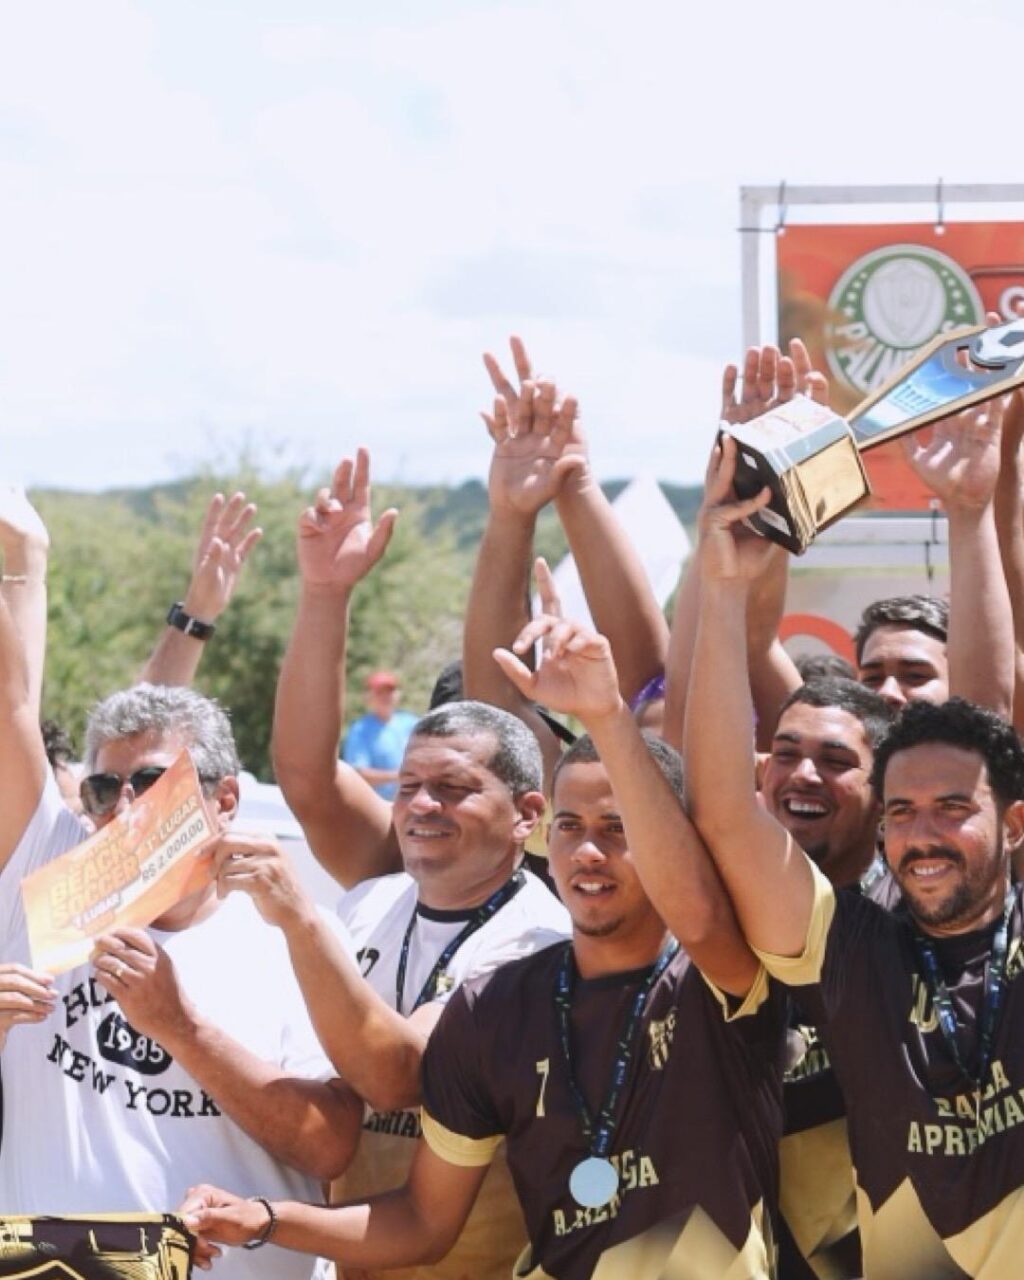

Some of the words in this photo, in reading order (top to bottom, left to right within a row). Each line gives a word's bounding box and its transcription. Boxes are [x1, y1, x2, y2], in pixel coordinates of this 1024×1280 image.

[48, 1033, 115, 1094] NEW
[125, 1080, 221, 1116] YORK
[535, 1057, 550, 1117] 7
